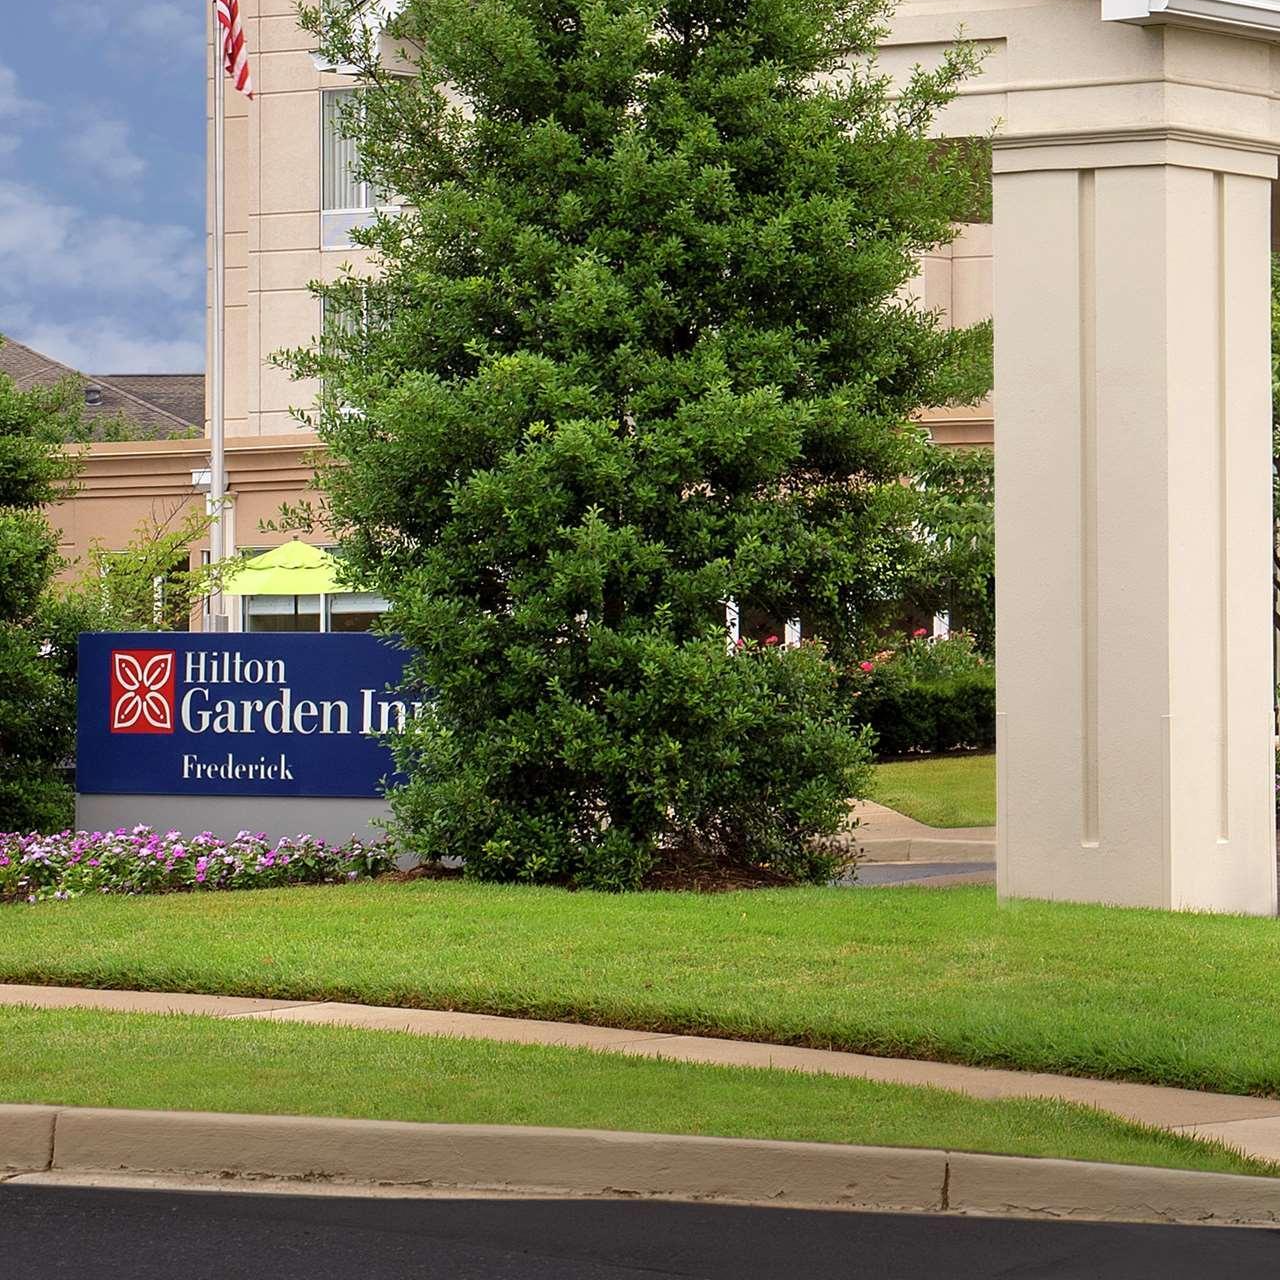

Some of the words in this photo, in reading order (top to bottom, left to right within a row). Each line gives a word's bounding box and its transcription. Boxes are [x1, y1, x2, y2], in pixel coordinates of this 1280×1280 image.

[183, 651, 287, 684] Hilton
[181, 687, 352, 735] Garden
[182, 752, 294, 780] Frederick
